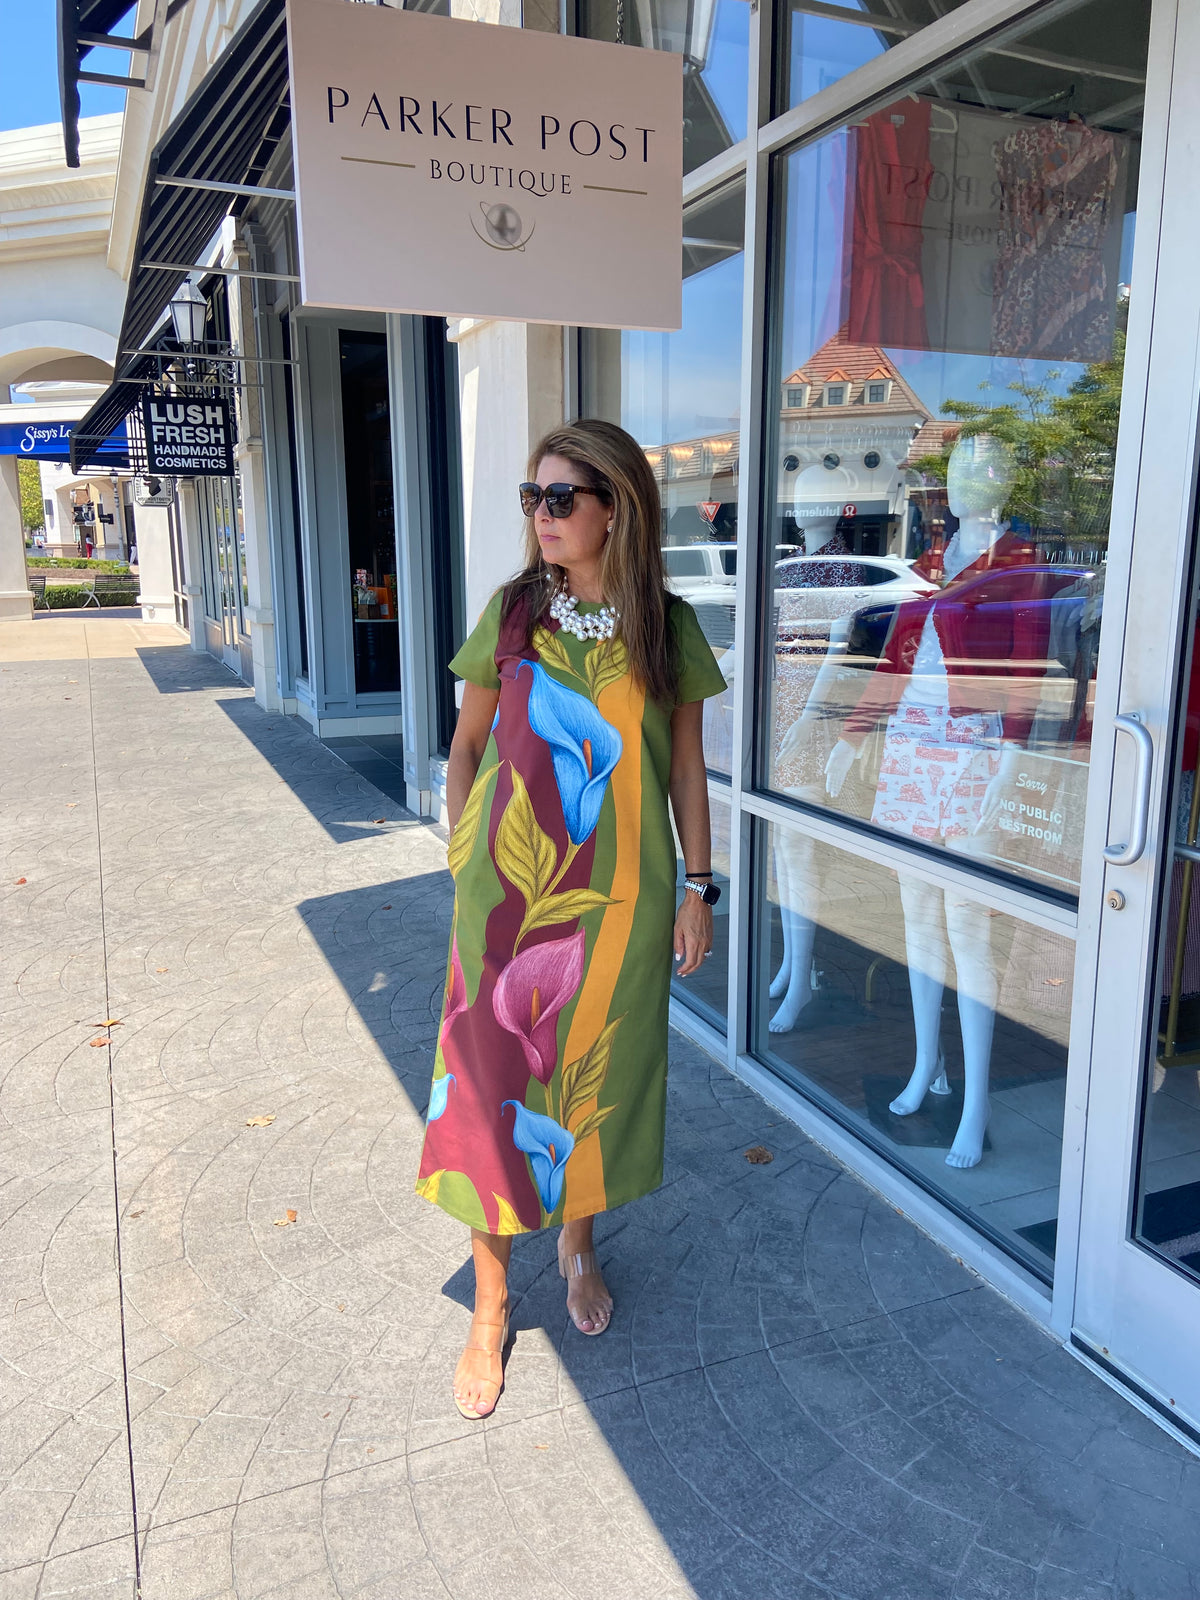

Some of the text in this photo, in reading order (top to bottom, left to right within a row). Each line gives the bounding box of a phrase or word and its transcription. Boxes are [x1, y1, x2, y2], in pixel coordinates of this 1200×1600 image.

[327, 86, 655, 163] PARKER POST
[429, 158, 572, 197] BOUTIQUE
[150, 403, 223, 425] LUSH
[20, 425, 58, 452] Sissy's
[152, 424, 226, 445] FRESH
[154, 444, 227, 457] HANDMADE
[155, 457, 227, 469] COSMETICS
[1016, 772, 1048, 796] Sorry
[1000, 798, 1062, 825] NO PUBLIC
